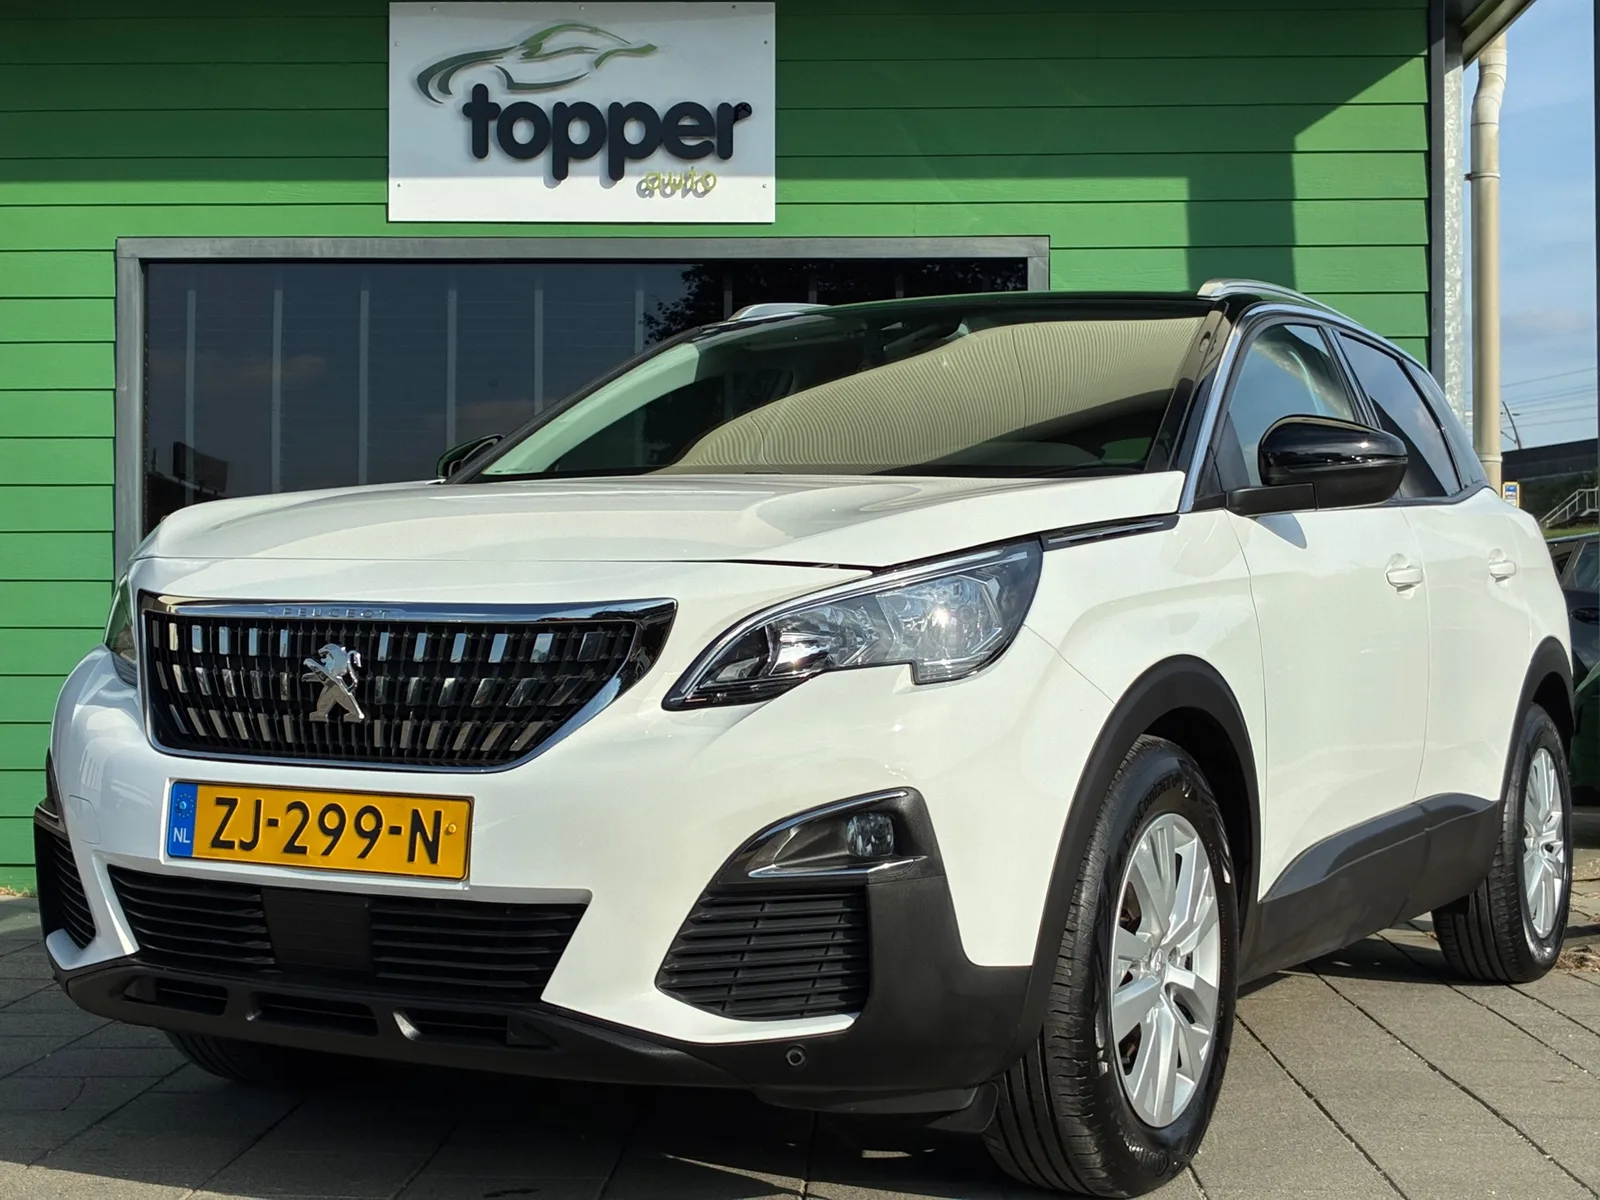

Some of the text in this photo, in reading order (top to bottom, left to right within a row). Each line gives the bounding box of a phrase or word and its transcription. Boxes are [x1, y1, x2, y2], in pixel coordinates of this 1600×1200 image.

[462, 83, 752, 181] topper
[646, 166, 717, 192] auto
[283, 607, 392, 619] PEUGEOT
[173, 827, 191, 844] NL
[210, 797, 442, 864] ZJ-299-N
